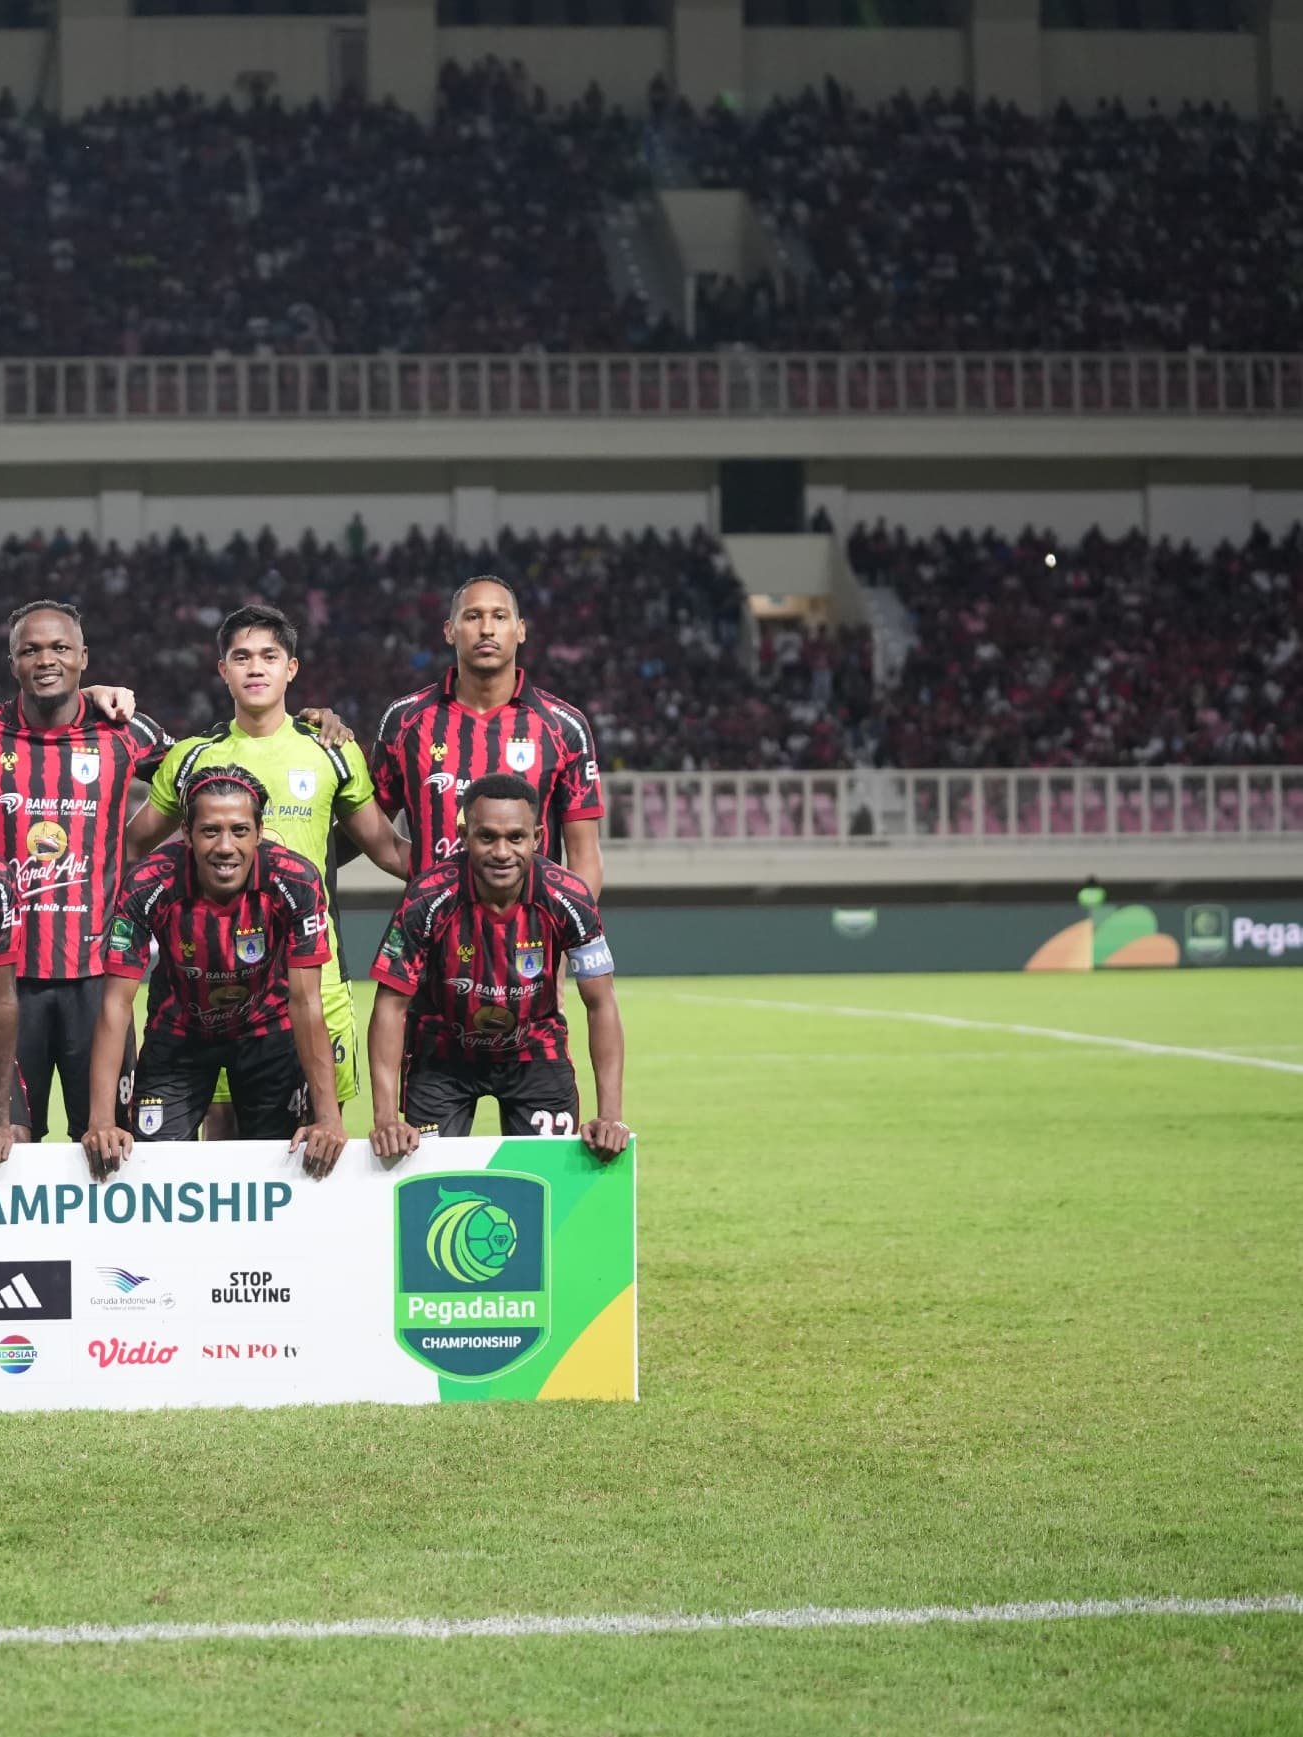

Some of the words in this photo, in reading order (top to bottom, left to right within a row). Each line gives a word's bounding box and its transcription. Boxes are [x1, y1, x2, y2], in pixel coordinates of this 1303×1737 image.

[25, 798, 59, 810] BANK
[61, 798, 97, 811] PAPUA
[279, 805, 313, 817] PAPUA
[9, 855, 56, 892] Kapal
[54, 852, 89, 881] Api
[33, 903, 59, 912] lebih
[62, 904, 88, 912] enak
[205, 971, 238, 980] BANK
[474, 983, 507, 997] BANK
[509, 980, 544, 996] PAPUA
[229, 1271, 273, 1287] STOP
[90, 1296, 118, 1305] Garuda
[120, 1296, 156, 1305] Indonesia
[211, 1287, 291, 1303] BULLYING
[408, 1296, 536, 1325] Pegadaian
[422, 1335, 522, 1348] CHAMPIONSHIP
[88, 1337, 179, 1368] Vidio
[202, 1343, 240, 1359] SIN
[248, 1343, 277, 1358] PO
[284, 1343, 300, 1358] tv
